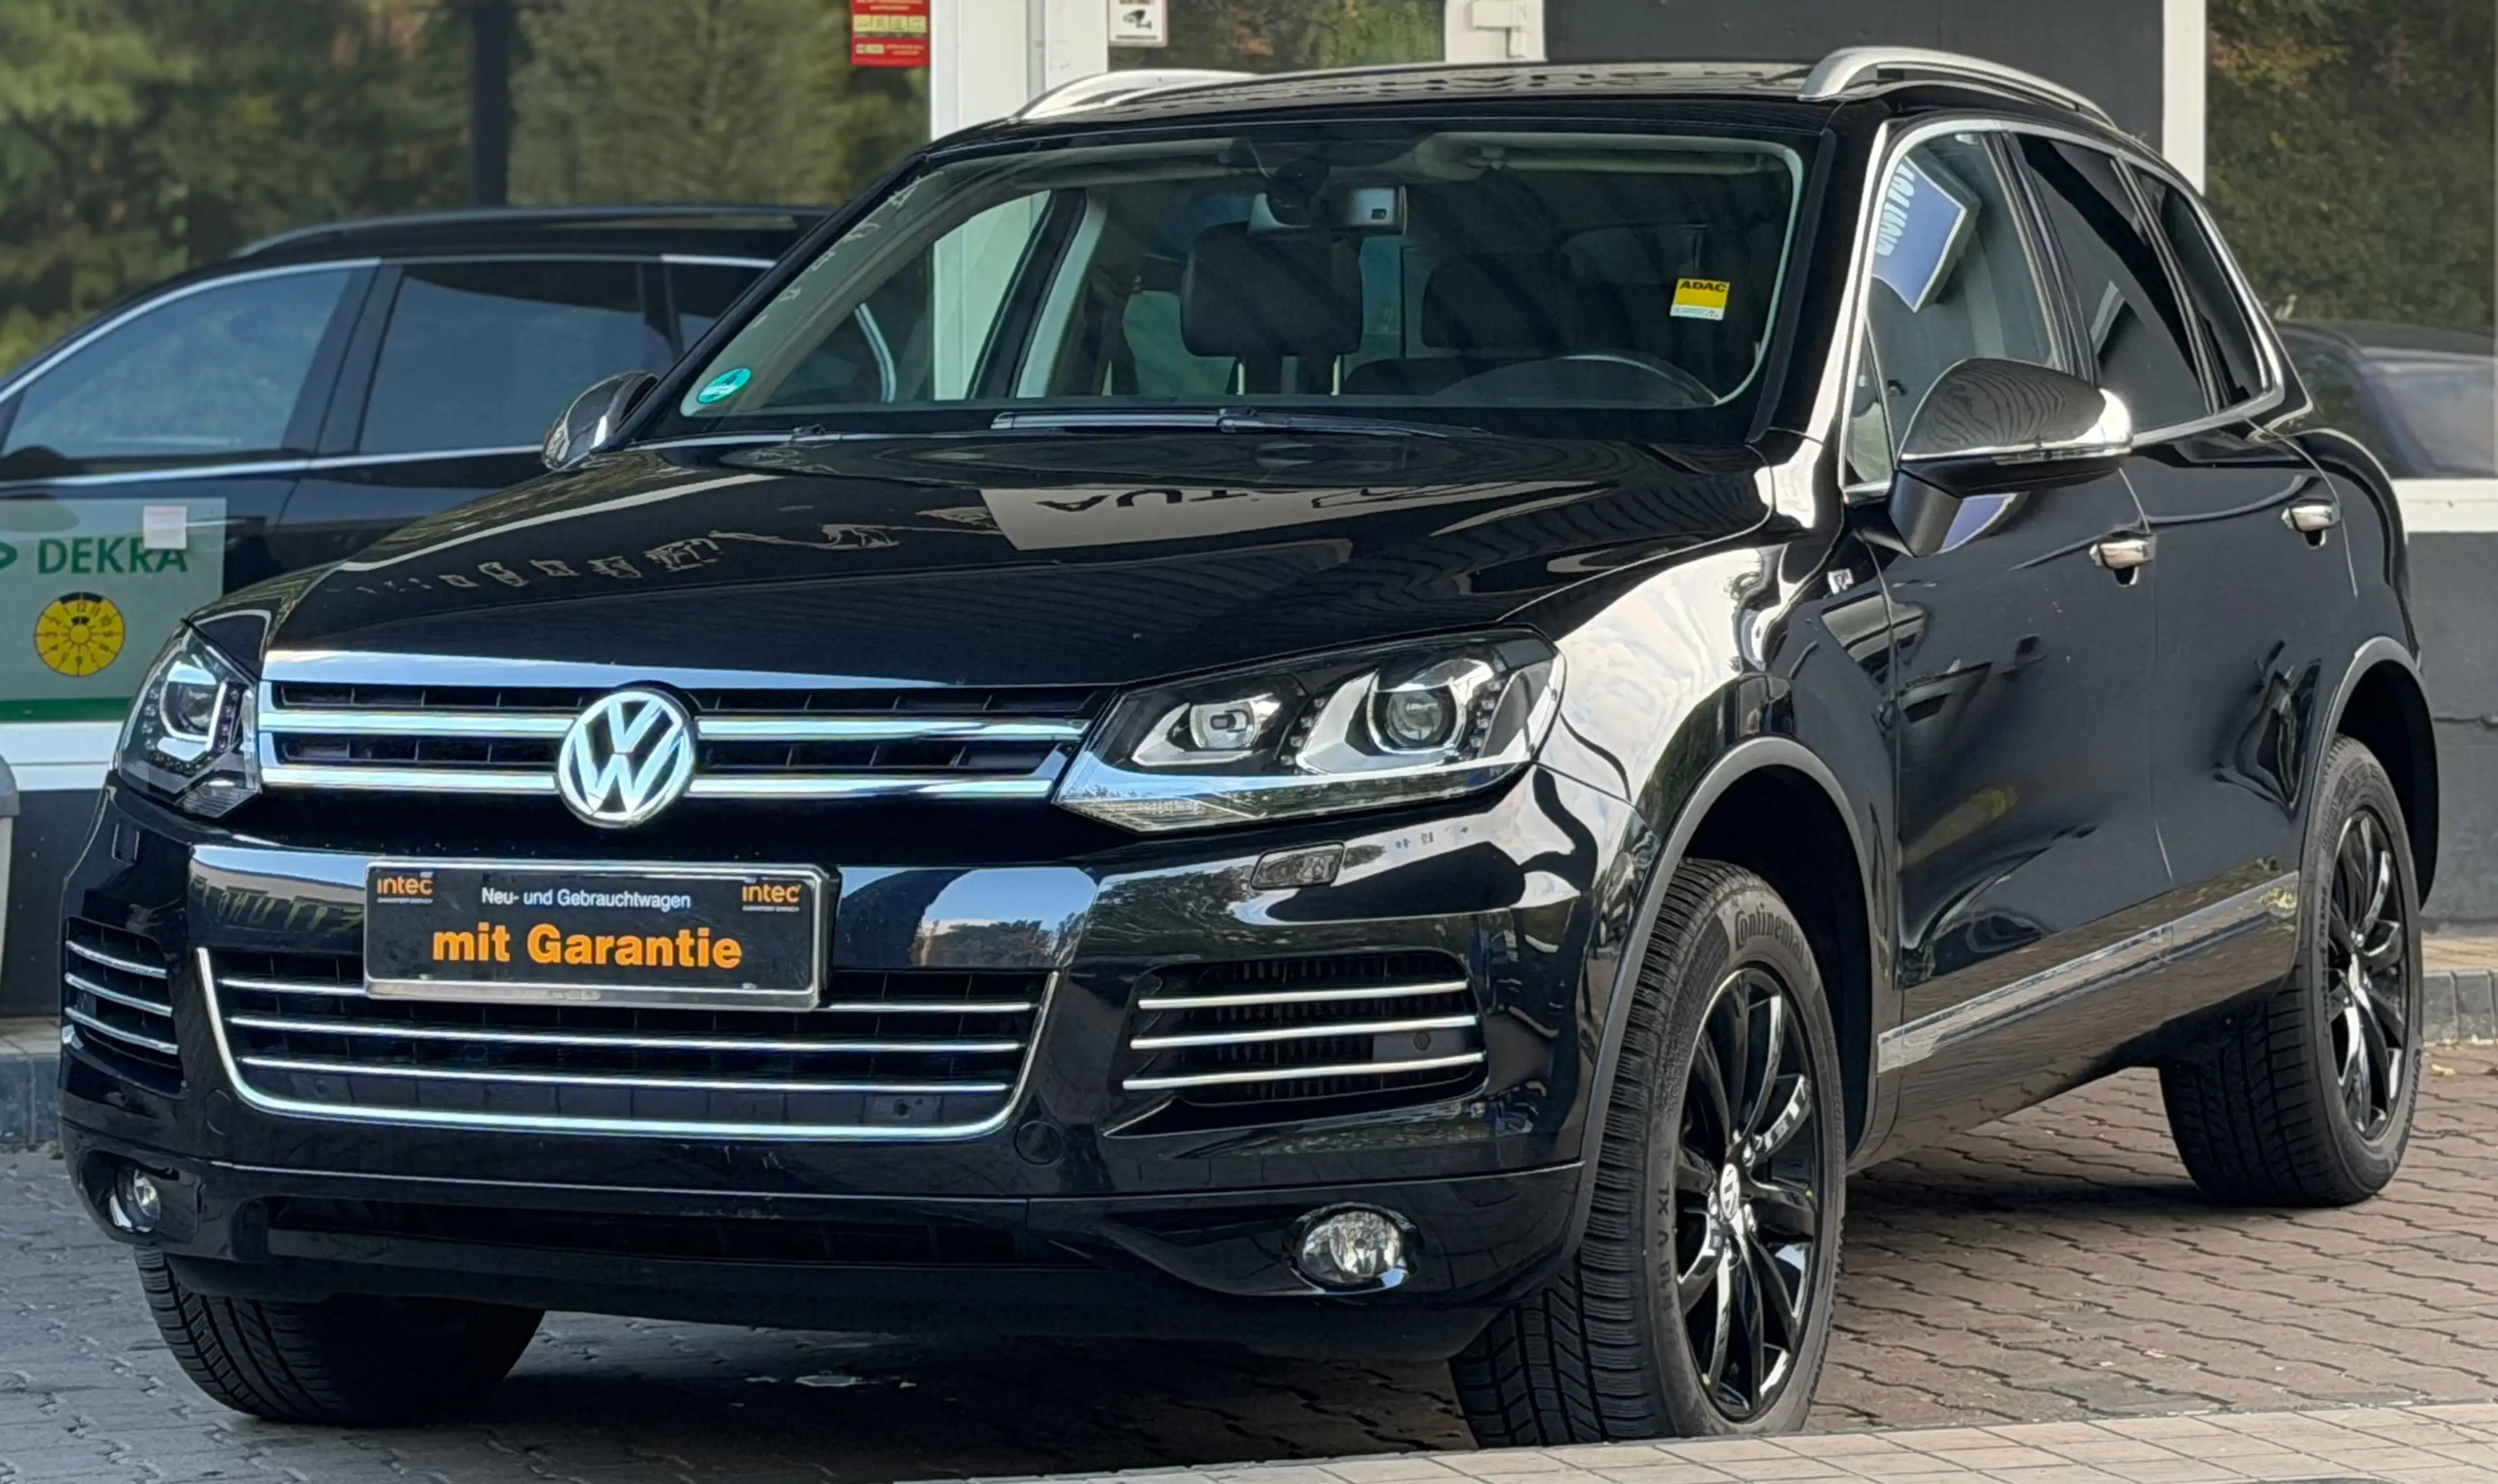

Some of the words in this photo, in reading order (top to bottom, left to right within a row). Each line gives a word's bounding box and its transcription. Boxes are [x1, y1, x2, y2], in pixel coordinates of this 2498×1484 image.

[1680, 280, 1726, 293] ADAC
[376, 875, 434, 895] intec
[742, 884, 801, 903] intec
[481, 888, 518, 905] Neu-
[524, 890, 554, 907] und
[557, 888, 691, 912] Gebrauchtwagen
[1735, 901, 1805, 964] Continental
[432, 922, 511, 963] mit
[527, 923, 742, 969] Garantie
